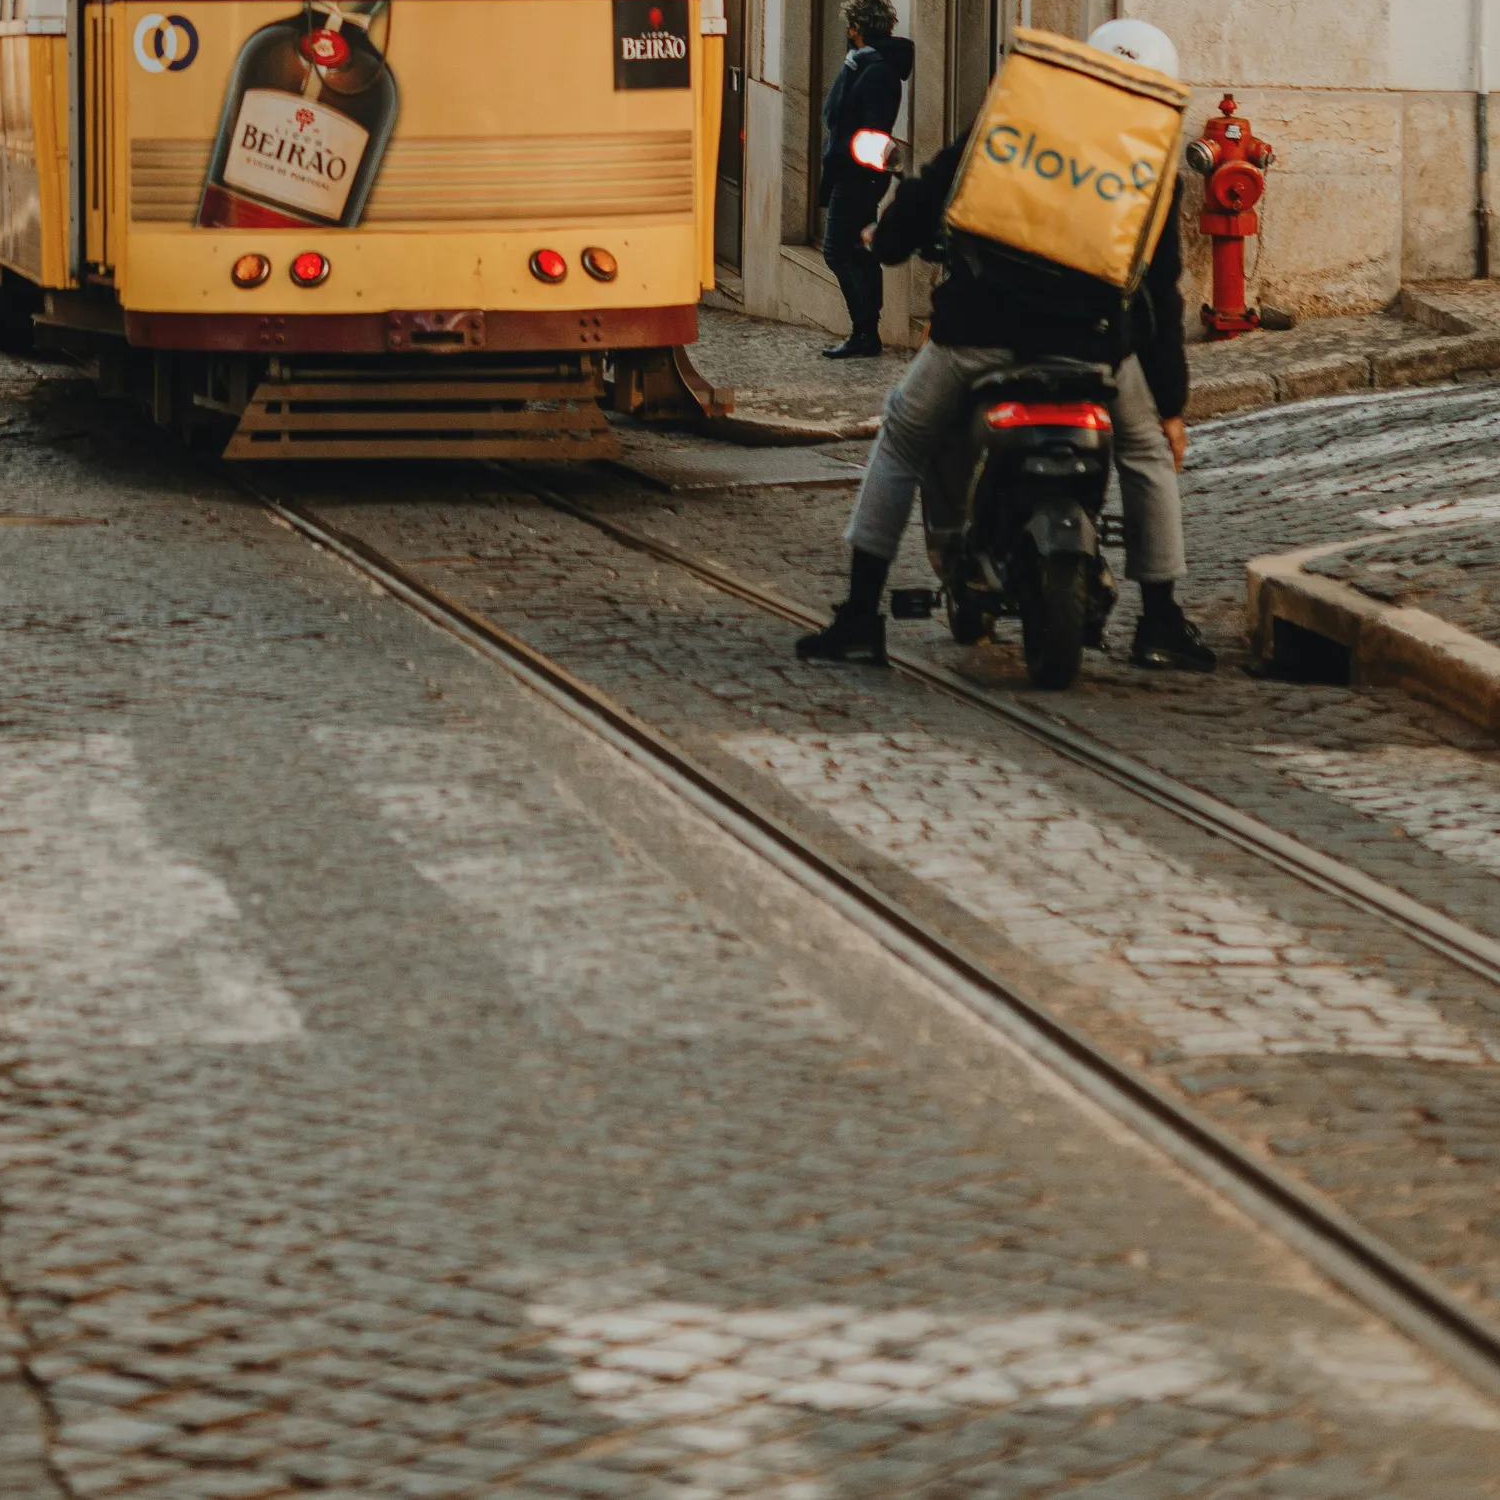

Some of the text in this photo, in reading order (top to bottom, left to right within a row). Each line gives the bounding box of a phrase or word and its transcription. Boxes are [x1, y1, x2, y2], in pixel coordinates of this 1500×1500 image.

[621, 35, 686, 60] BEIRÃO
[240, 123, 347, 182] BEIRÃO
[985, 125, 1125, 200] Glovo
